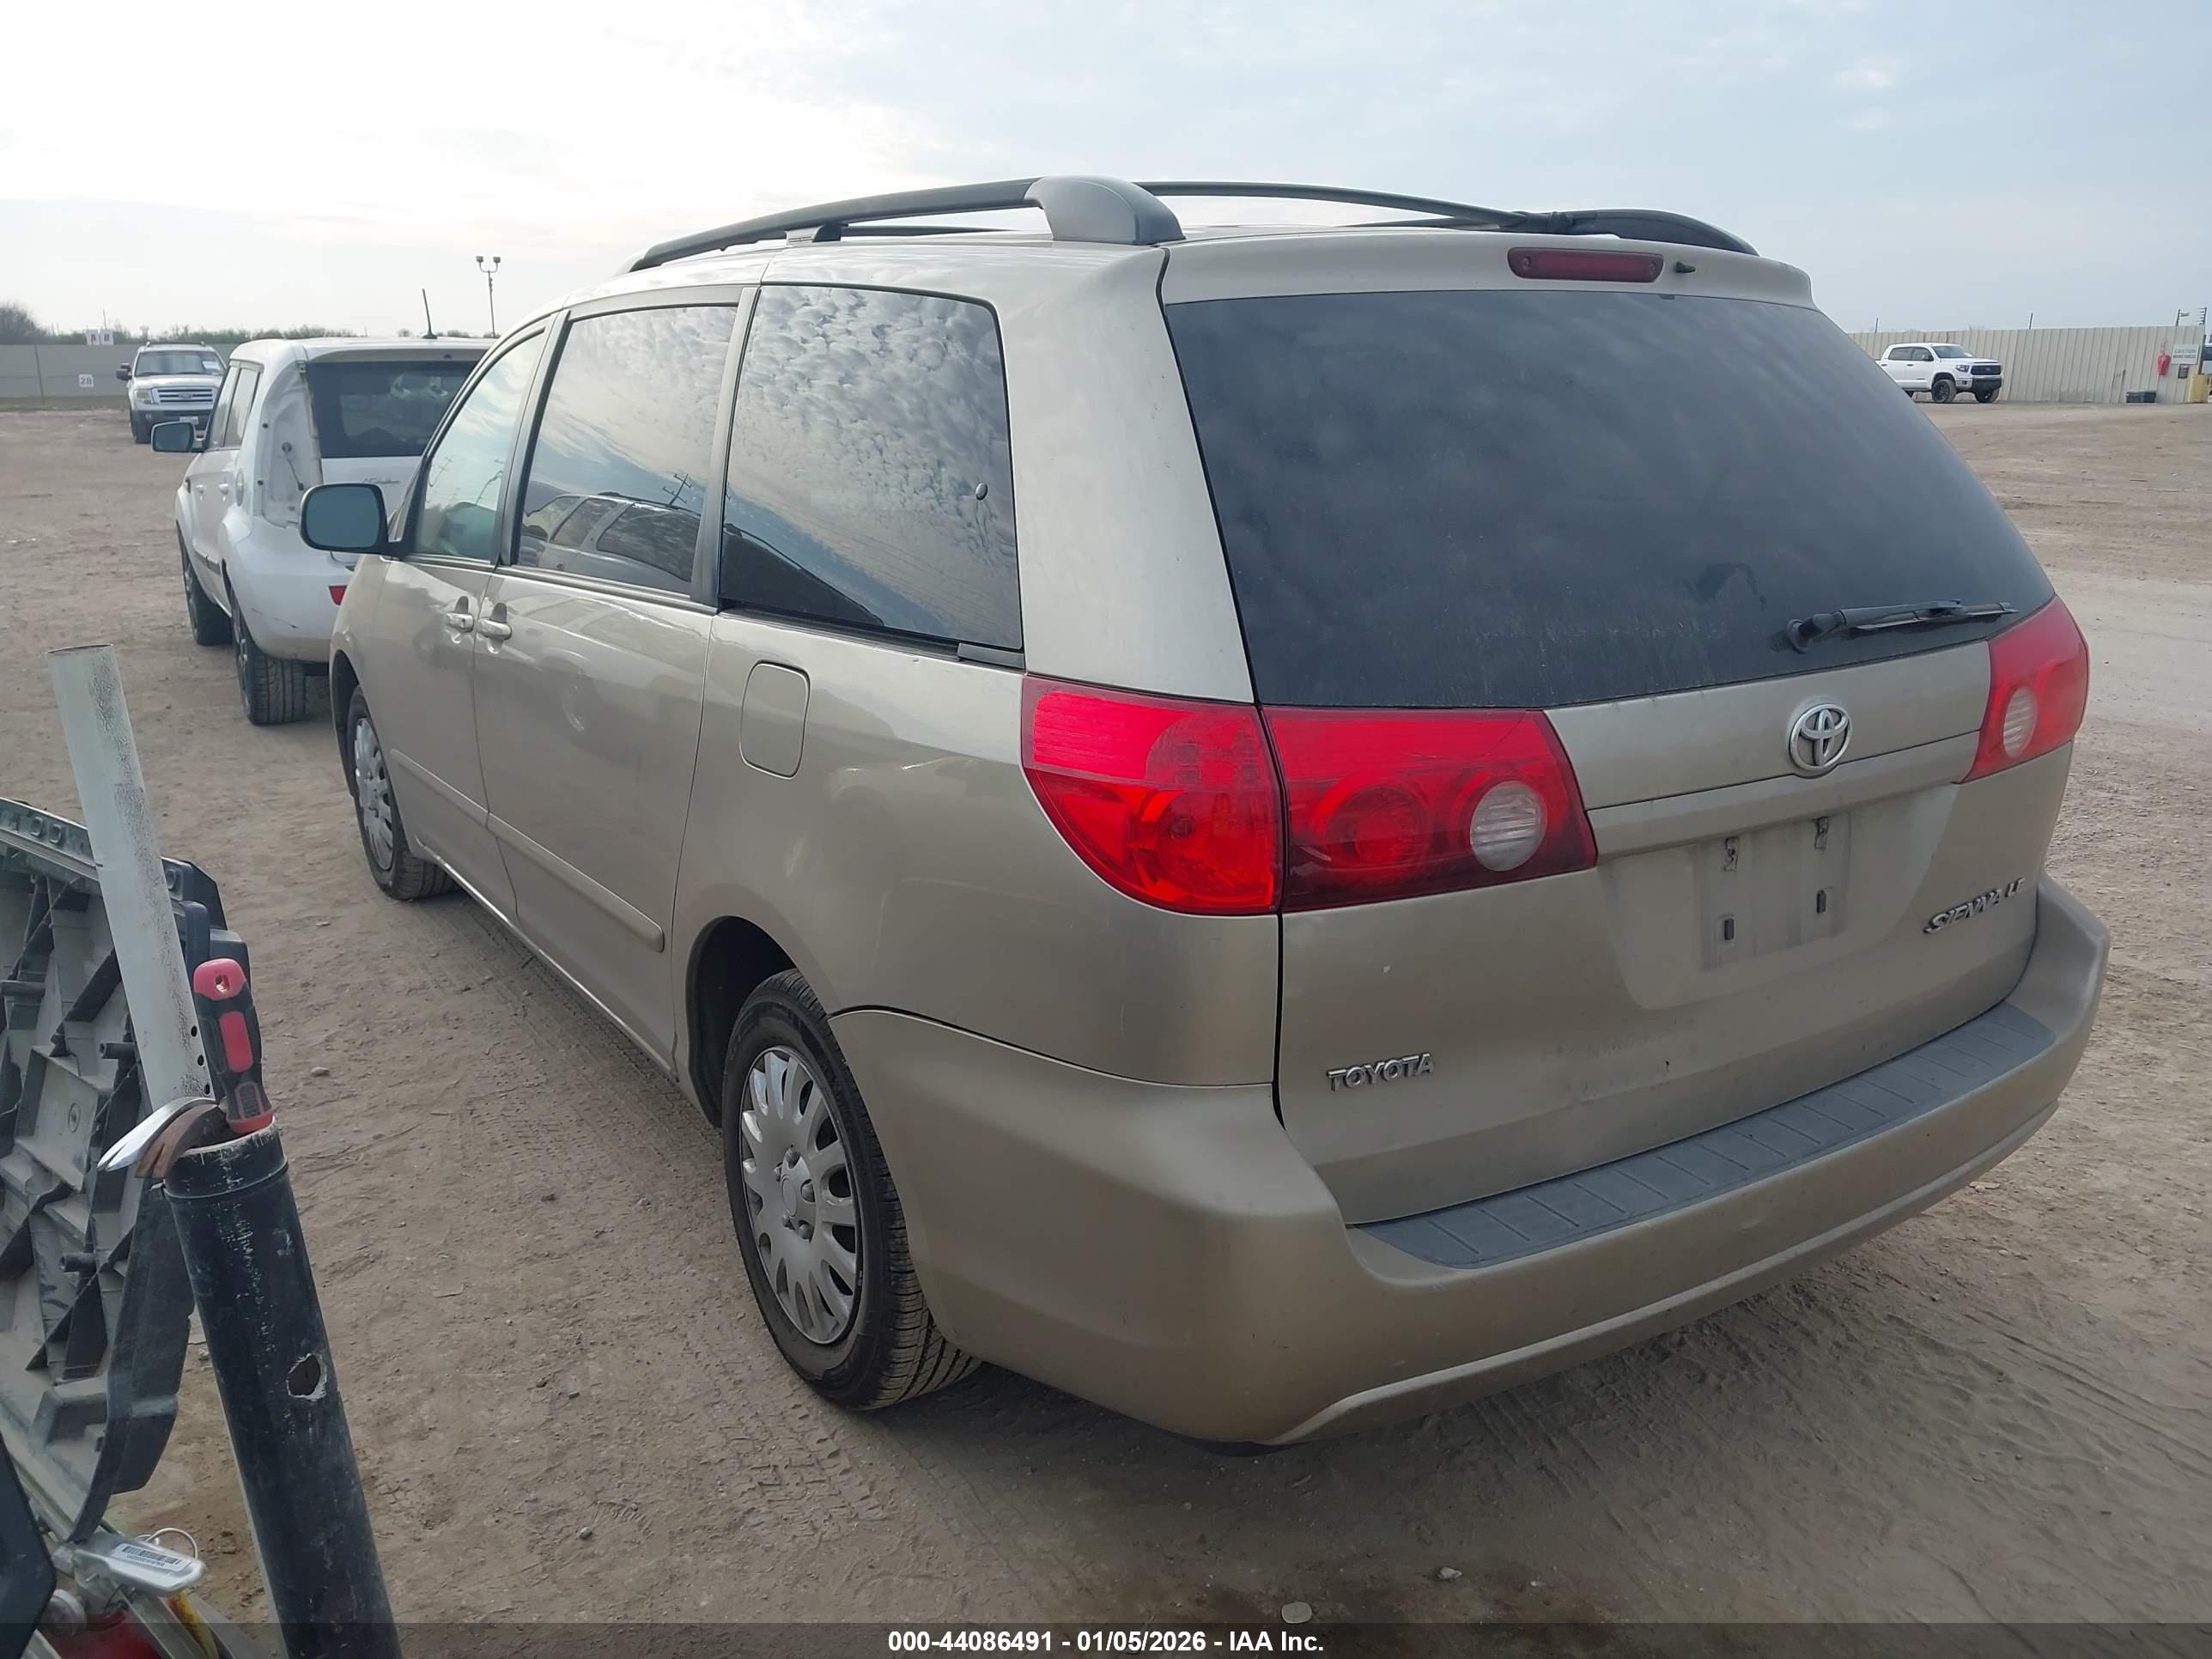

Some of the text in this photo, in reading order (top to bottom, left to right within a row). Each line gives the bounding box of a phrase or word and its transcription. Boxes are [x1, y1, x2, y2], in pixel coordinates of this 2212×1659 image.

[1923, 877, 2026, 934] SIENNA LE
[1326, 1051, 1436, 1092] TOYOTA
